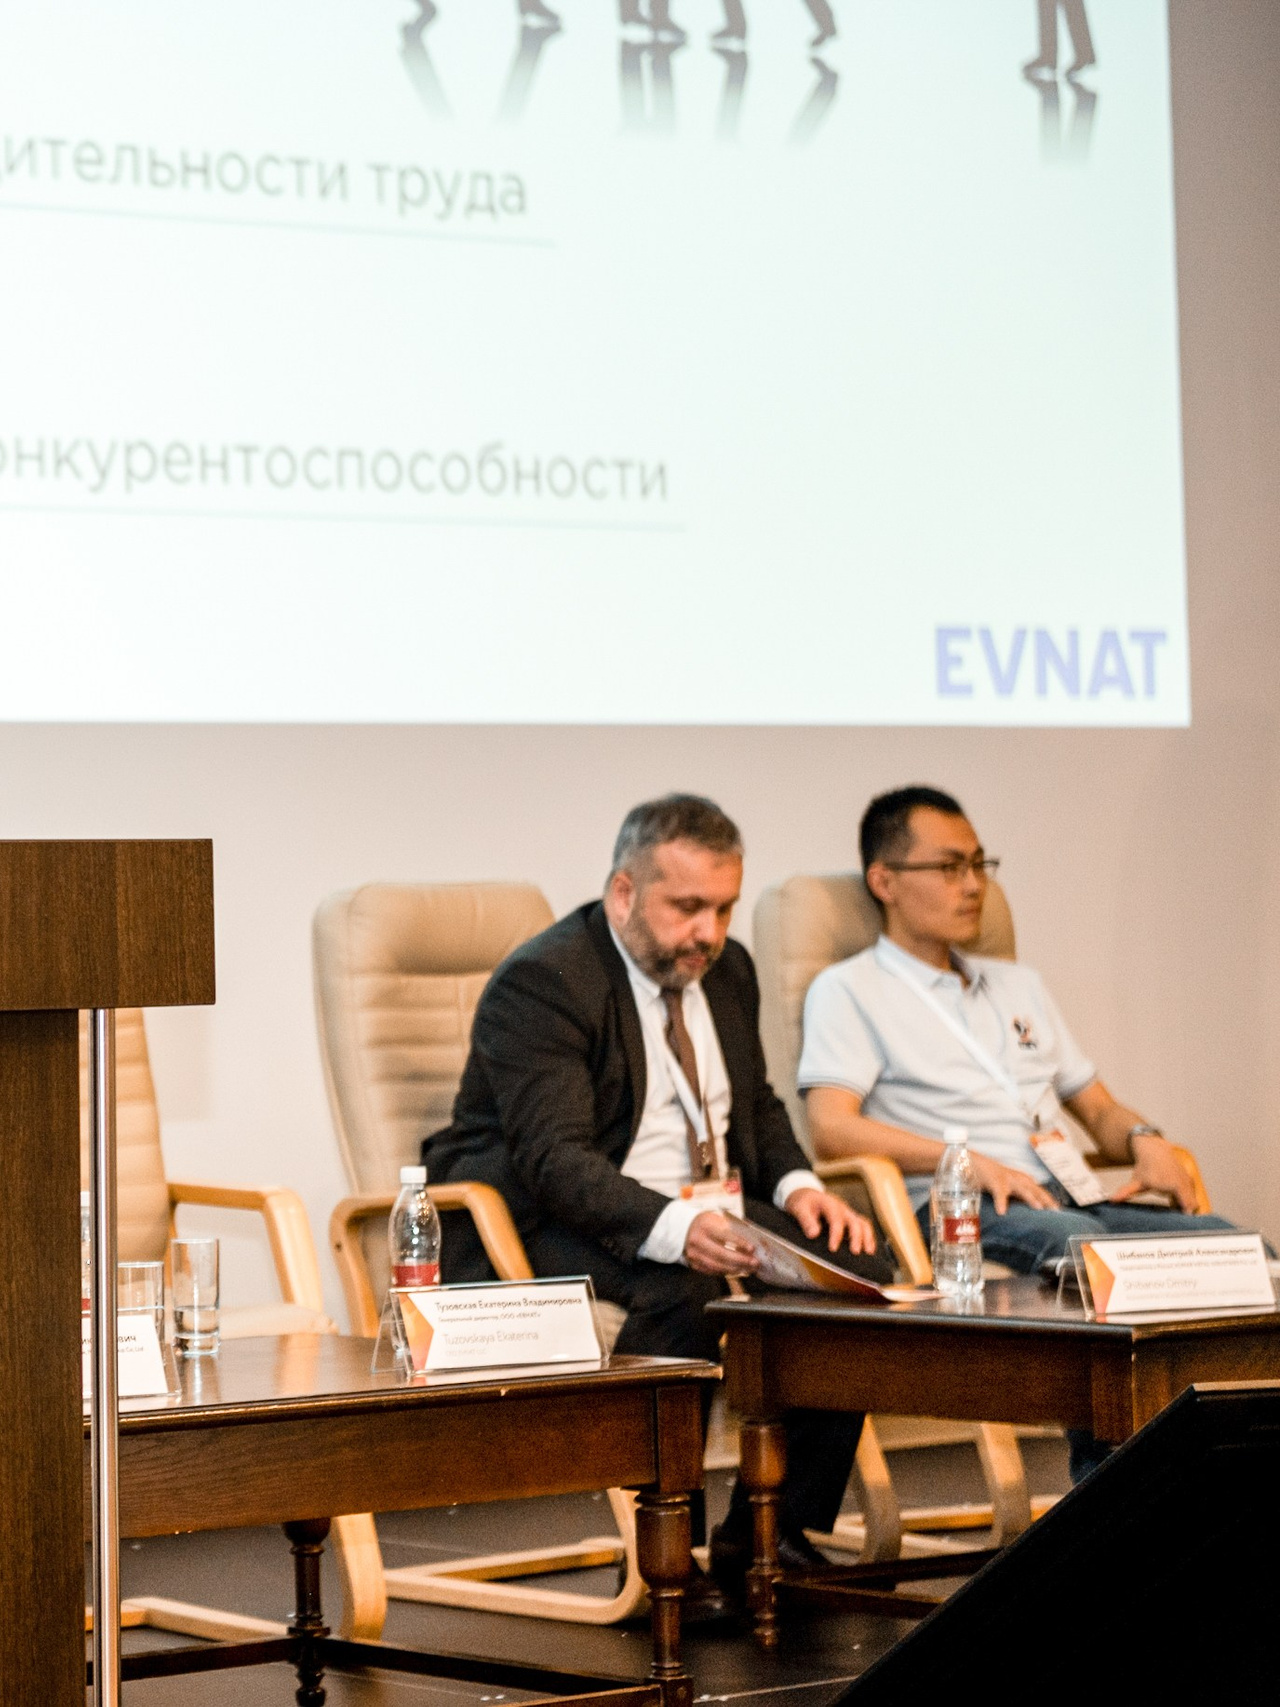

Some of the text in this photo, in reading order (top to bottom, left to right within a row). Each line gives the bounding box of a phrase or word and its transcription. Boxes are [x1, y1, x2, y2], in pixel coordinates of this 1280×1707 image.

[368, 161, 527, 221] труда
[934, 625, 1167, 697] EVNAT
[435, 1298, 582, 1313] Тузовская Екатерина Владимировна
[443, 1331, 539, 1346] Tuzovskaya Ekaterina
